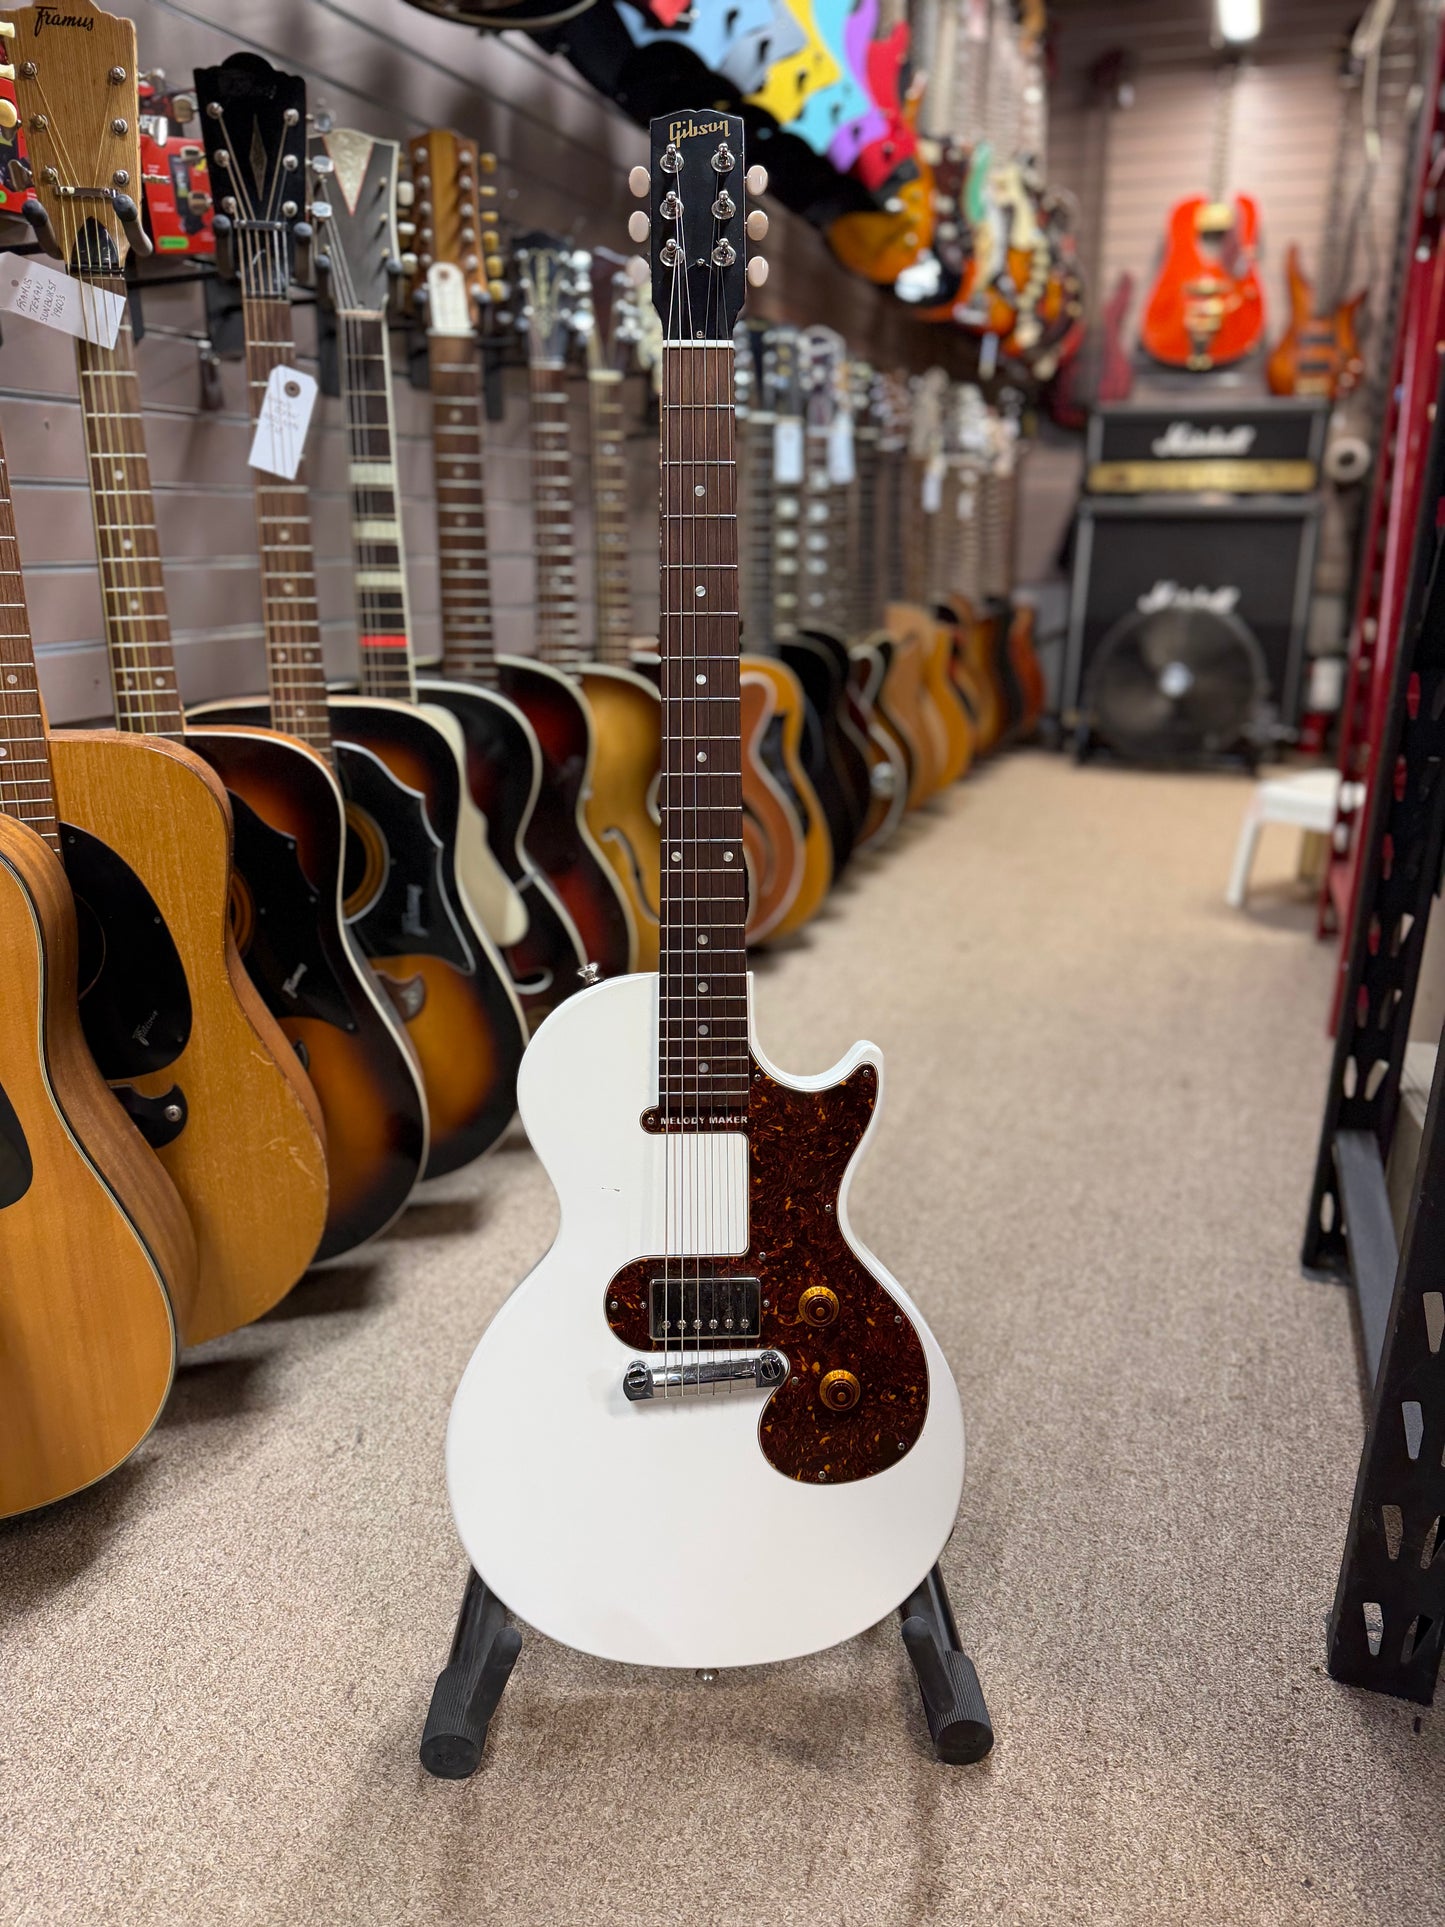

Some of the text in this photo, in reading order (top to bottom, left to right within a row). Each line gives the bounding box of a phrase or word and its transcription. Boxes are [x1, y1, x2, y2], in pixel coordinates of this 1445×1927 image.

[34, 6, 94, 37] Framus
[669, 119, 731, 149] Gibson
[29, 281, 44, 314] TEXAN
[39, 279, 57, 323] SUNBURST
[660, 1116, 748, 1125] MELODY MAKER
